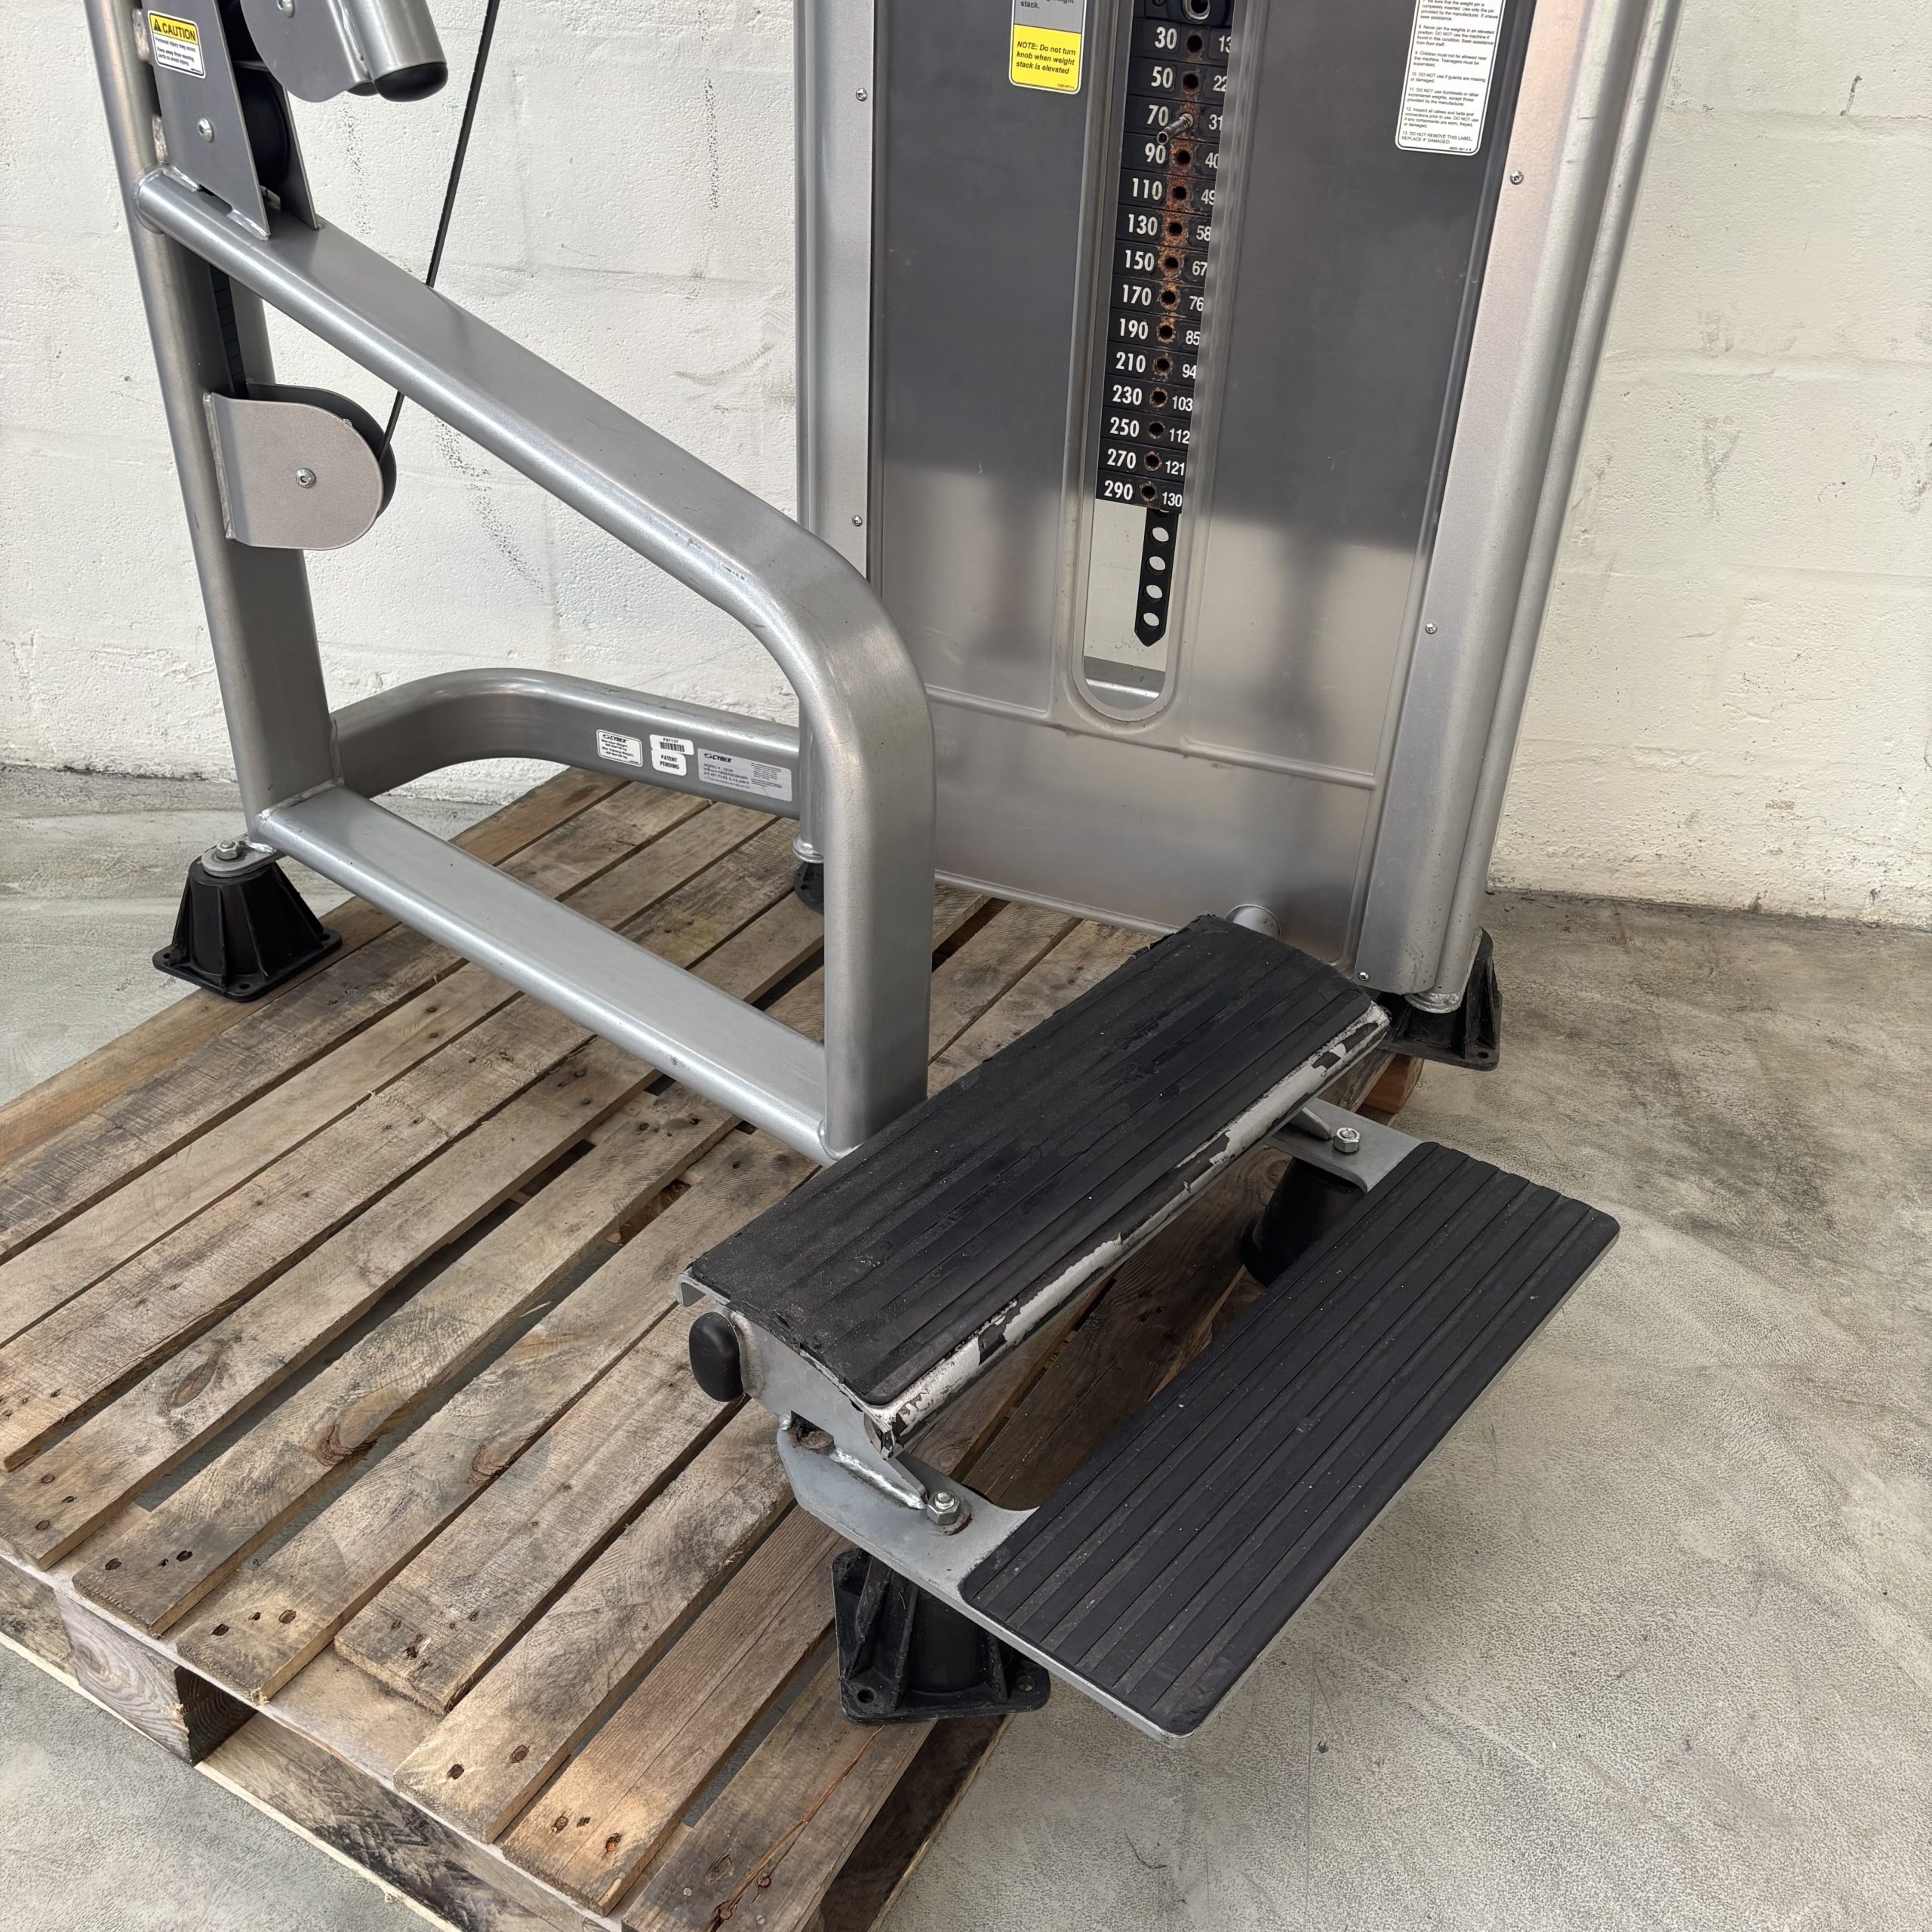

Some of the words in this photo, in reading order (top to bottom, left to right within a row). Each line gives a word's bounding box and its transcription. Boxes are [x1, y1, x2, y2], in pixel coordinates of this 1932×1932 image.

[162, 23, 196, 41] CAUTION
[1155, 27, 1177, 49] 30
[1017, 41, 1038, 50] NOTE:
[1219, 35, 1231, 53] 13
[1042, 66, 1069, 74] elevated
[1151, 66, 1173, 88] 50
[1147, 105, 1168, 127] 70
[1209, 114, 1223, 131] 31
[1145, 143, 1166, 164] 90
[1133, 178, 1162, 200] 110
[1201, 189, 1215, 205] 49
[1128, 214, 1158, 235] 130
[1196, 226, 1211, 241] 58
[1126, 250, 1155, 271] 150
[1192, 261, 1208, 276] 67
[1123, 285, 1152, 306] 170
[1189, 296, 1204, 311] 76
[1120, 318, 1148, 339] 190
[1186, 331, 1201, 345] 85
[1115, 352, 1146, 373] 210
[1182, 364, 1197, 379] 94
[1112, 385, 1142, 405] 230
[1172, 396, 1192, 411] 103
[1110, 417, 1139, 437] 250
[1170, 428, 1189, 444] 112
[1107, 448, 1136, 469] 270
[1165, 460, 1185, 475] 121
[1104, 480, 1133, 500] 290
[1162, 492, 1182, 507] 130
